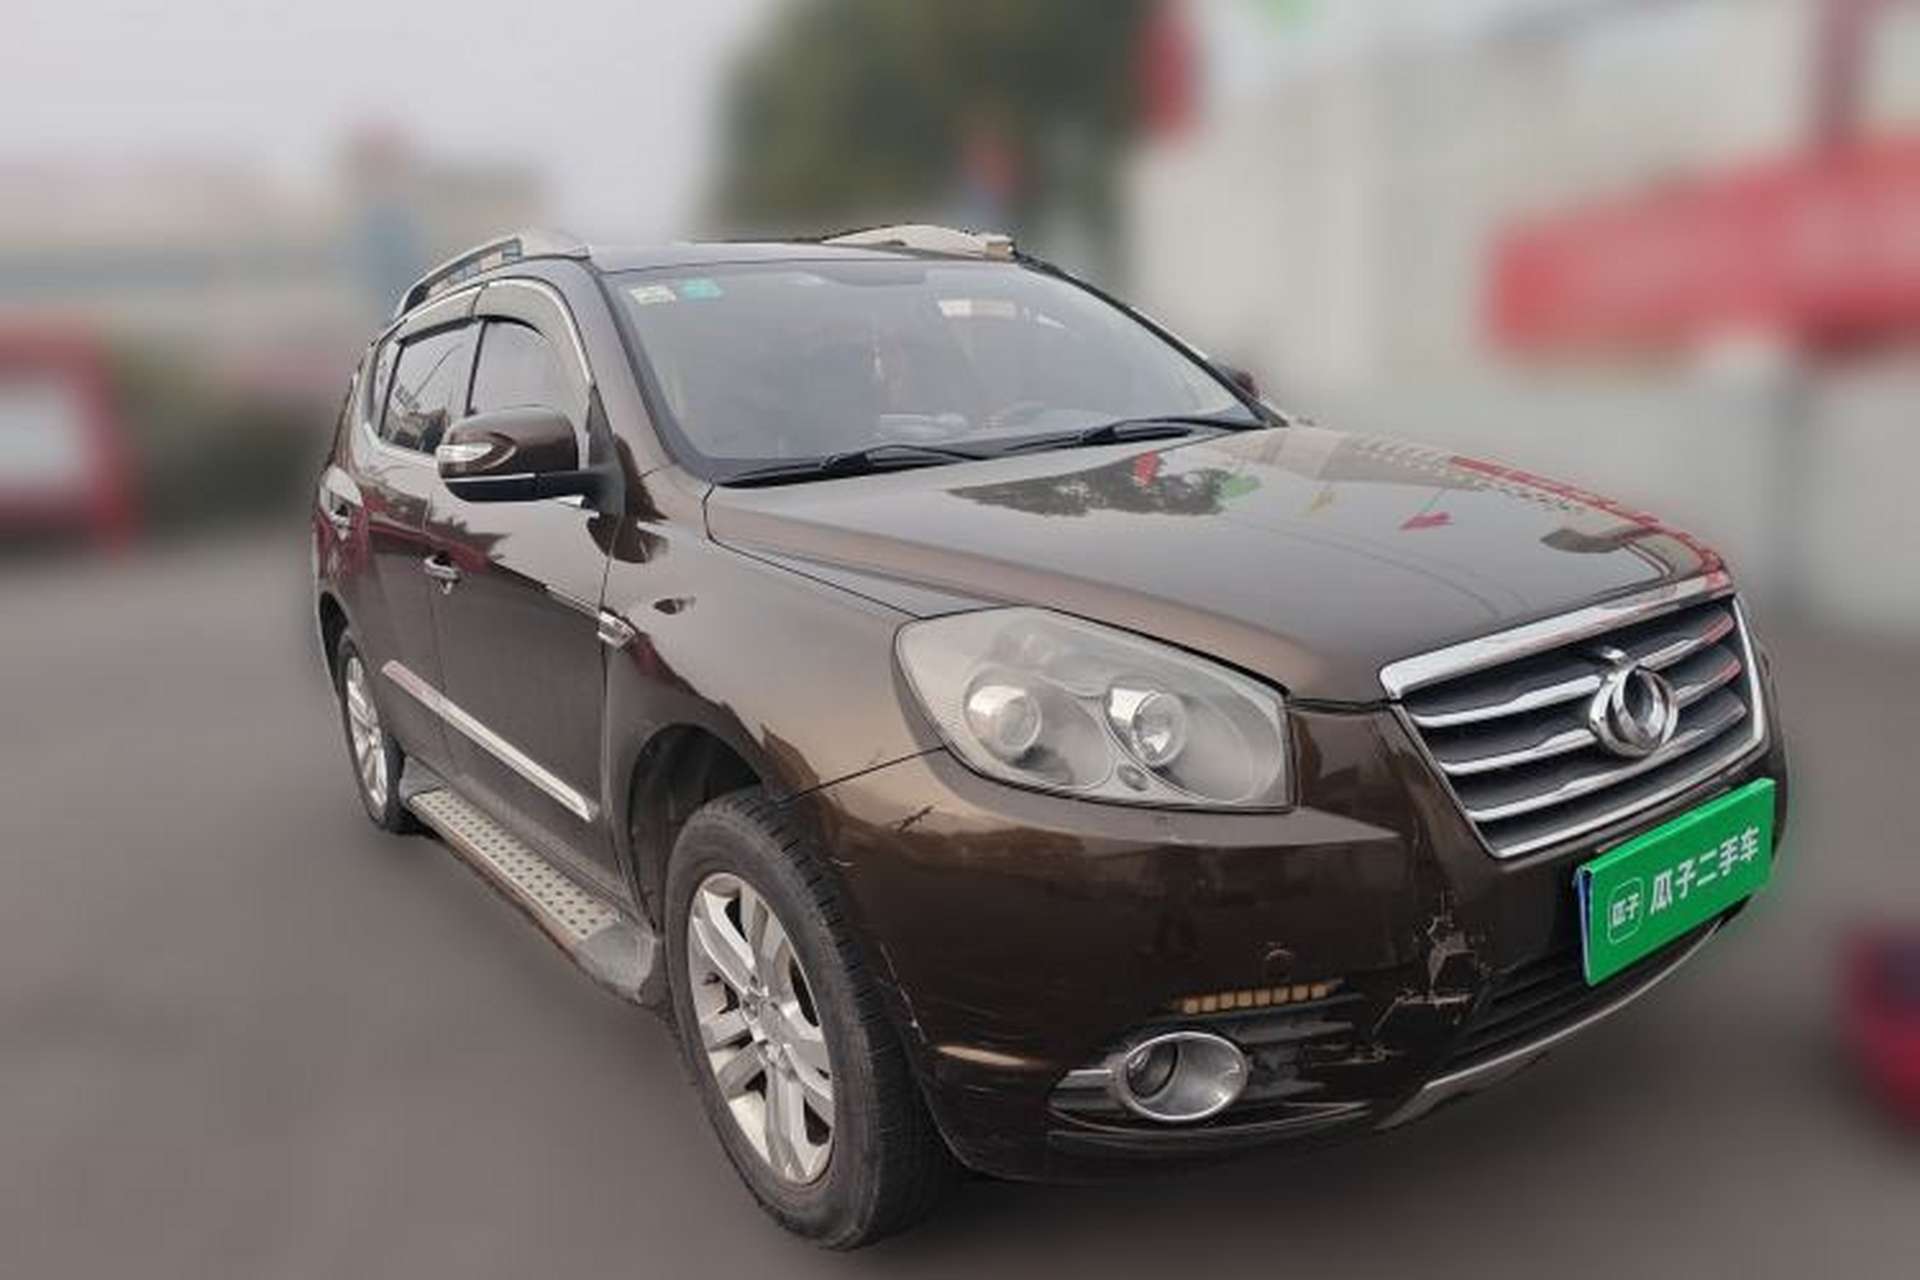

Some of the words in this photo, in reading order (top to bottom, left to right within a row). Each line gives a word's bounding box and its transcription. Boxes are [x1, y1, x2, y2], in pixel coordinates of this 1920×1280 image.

[1650, 826, 1760, 915] 瓜子二手车
